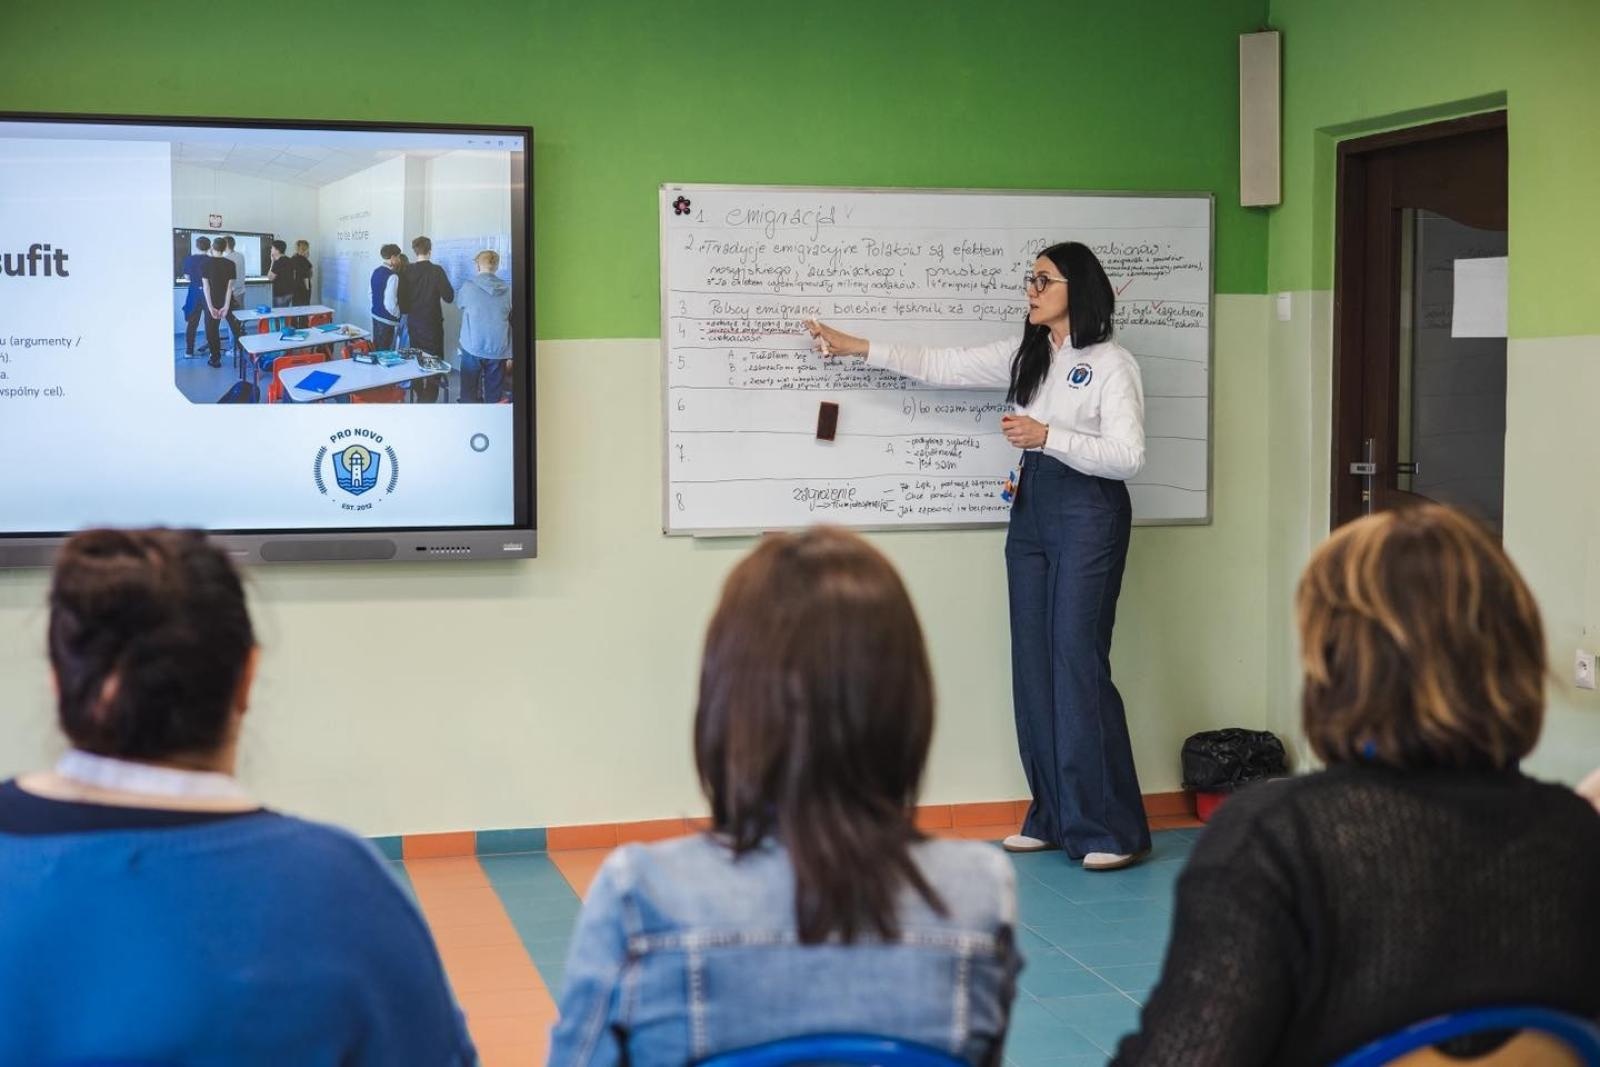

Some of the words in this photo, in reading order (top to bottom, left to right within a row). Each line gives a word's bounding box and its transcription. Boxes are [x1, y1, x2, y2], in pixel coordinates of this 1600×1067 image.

[861, 237, 922, 257] Polaków
[928, 243, 944, 263] są
[952, 240, 1004, 263] efektem
[0, 243, 70, 278] ufit
[925, 262, 1002, 288] pruskiego
[708, 298, 751, 321] Polscy
[755, 302, 822, 321] emigranci
[833, 301, 888, 316] boleśnie
[894, 301, 943, 320] tęsknili
[948, 302, 966, 315] za
[11, 336, 73, 352] (argumenty
[919, 400, 933, 415] bo
[330, 429, 352, 444] PRO
[354, 428, 384, 444] NOVO
[934, 460, 957, 470] sam
[341, 502, 357, 511] EST.
[356, 503, 373, 511] 2012
